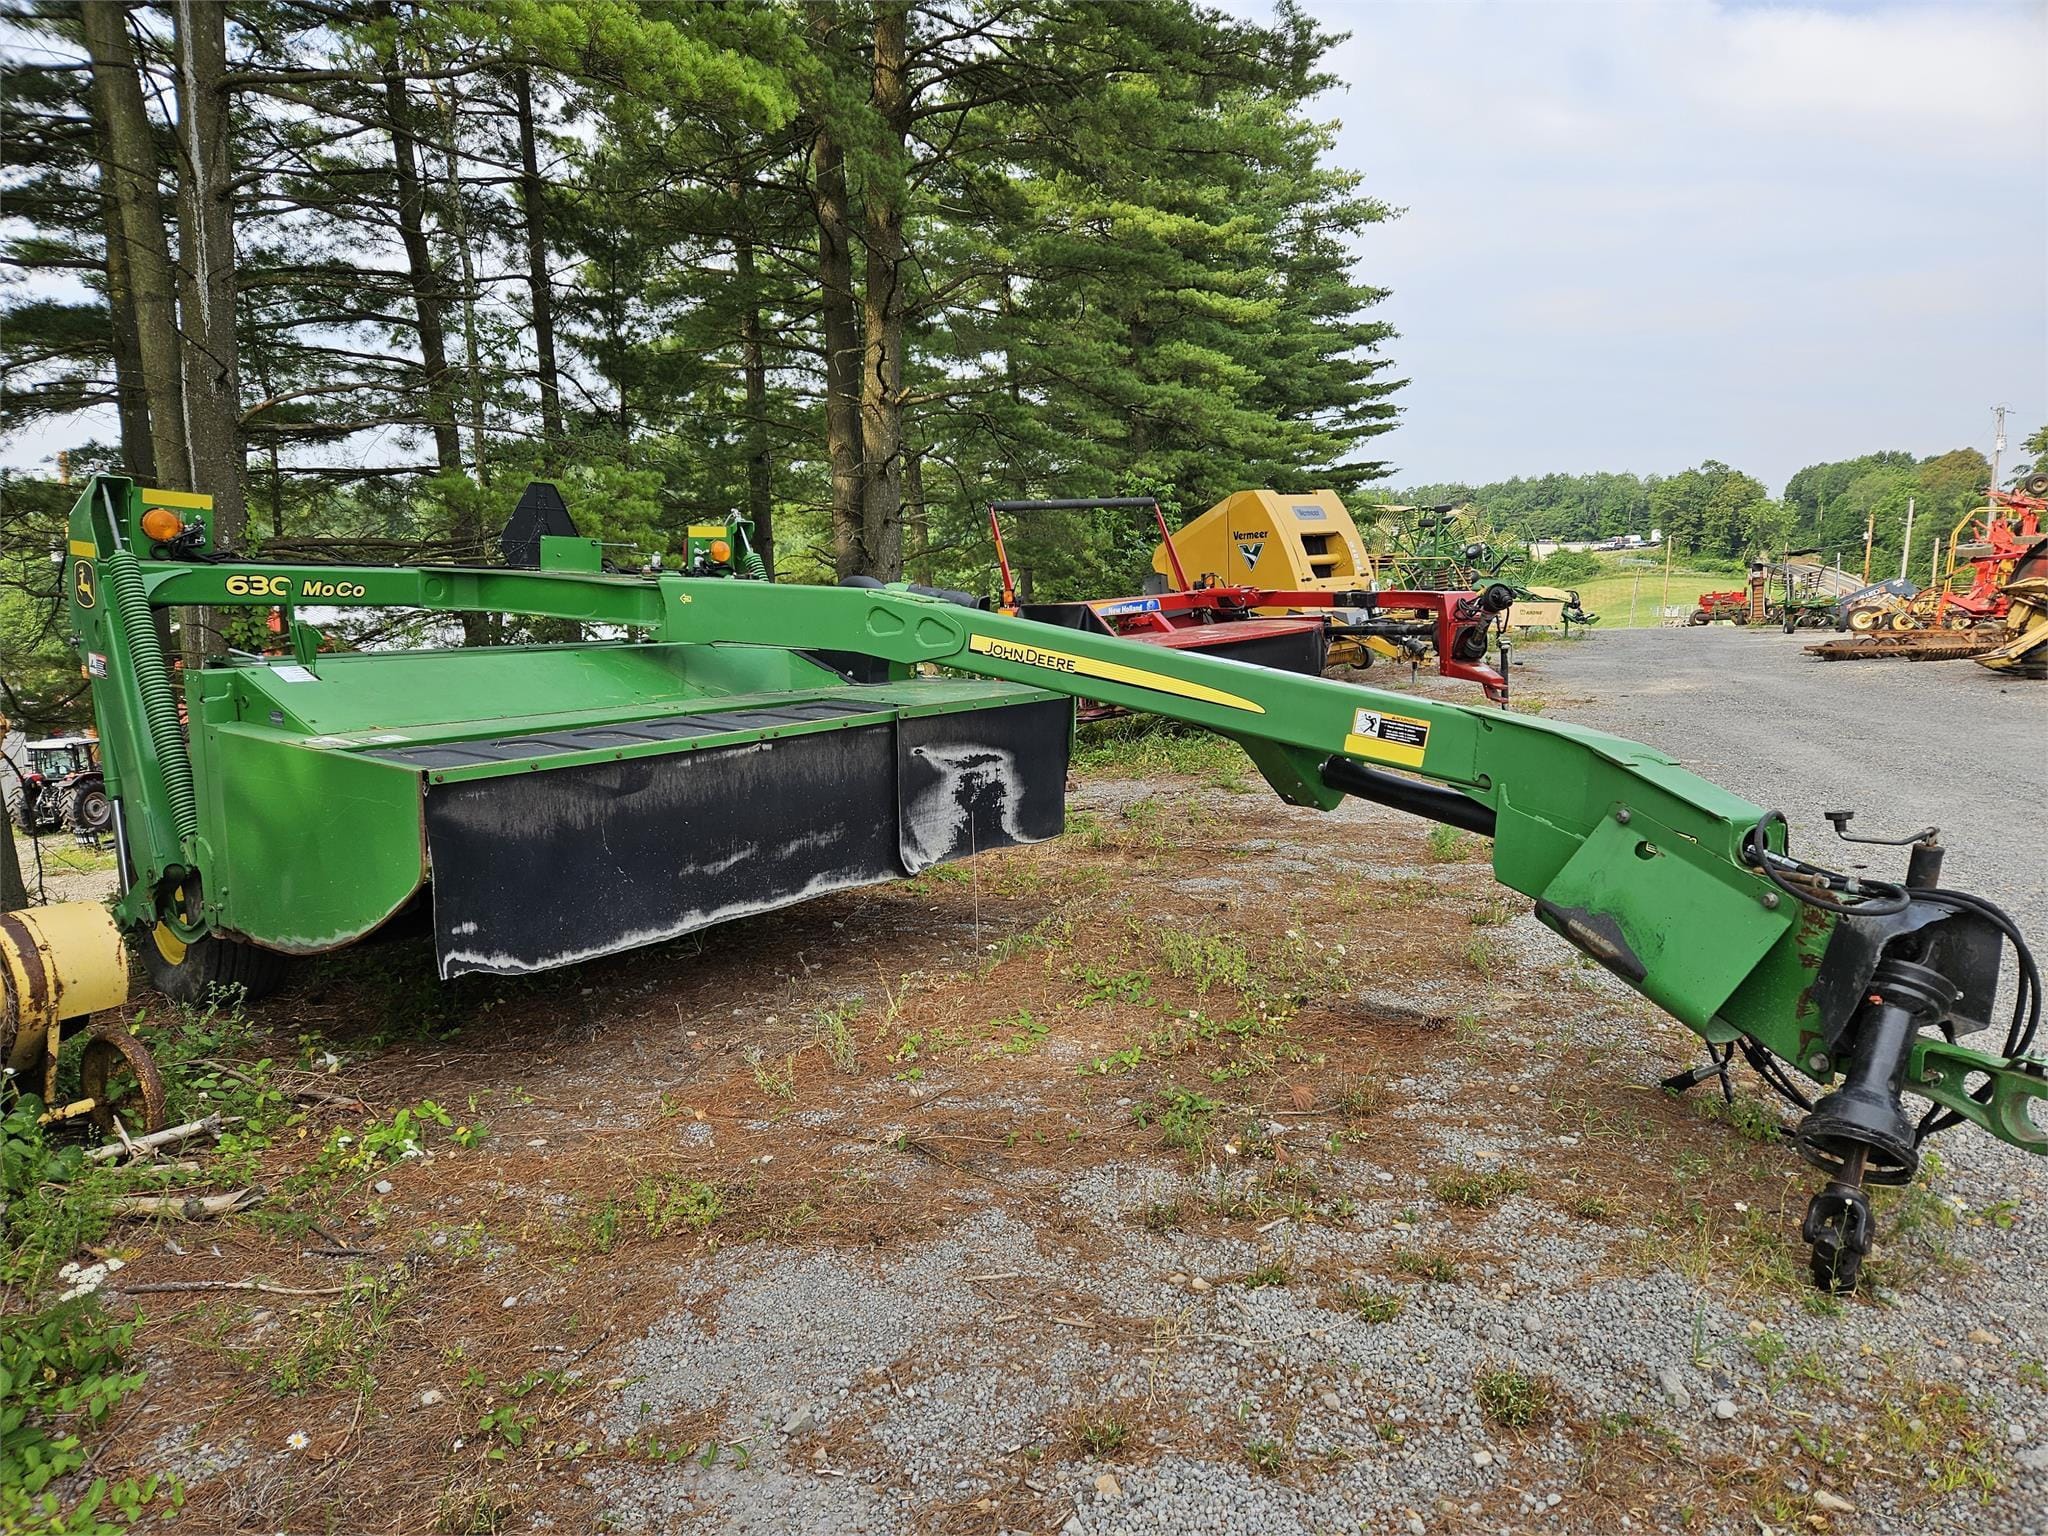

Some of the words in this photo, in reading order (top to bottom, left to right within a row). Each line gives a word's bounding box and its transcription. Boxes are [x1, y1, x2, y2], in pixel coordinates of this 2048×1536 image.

[1233, 531, 1268, 540] Vermeer
[302, 581, 366, 597] MoCo
[1121, 604, 1143, 614] Holland
[984, 641, 1024, 662] JOHN
[1026, 649, 1076, 671] DEERE
